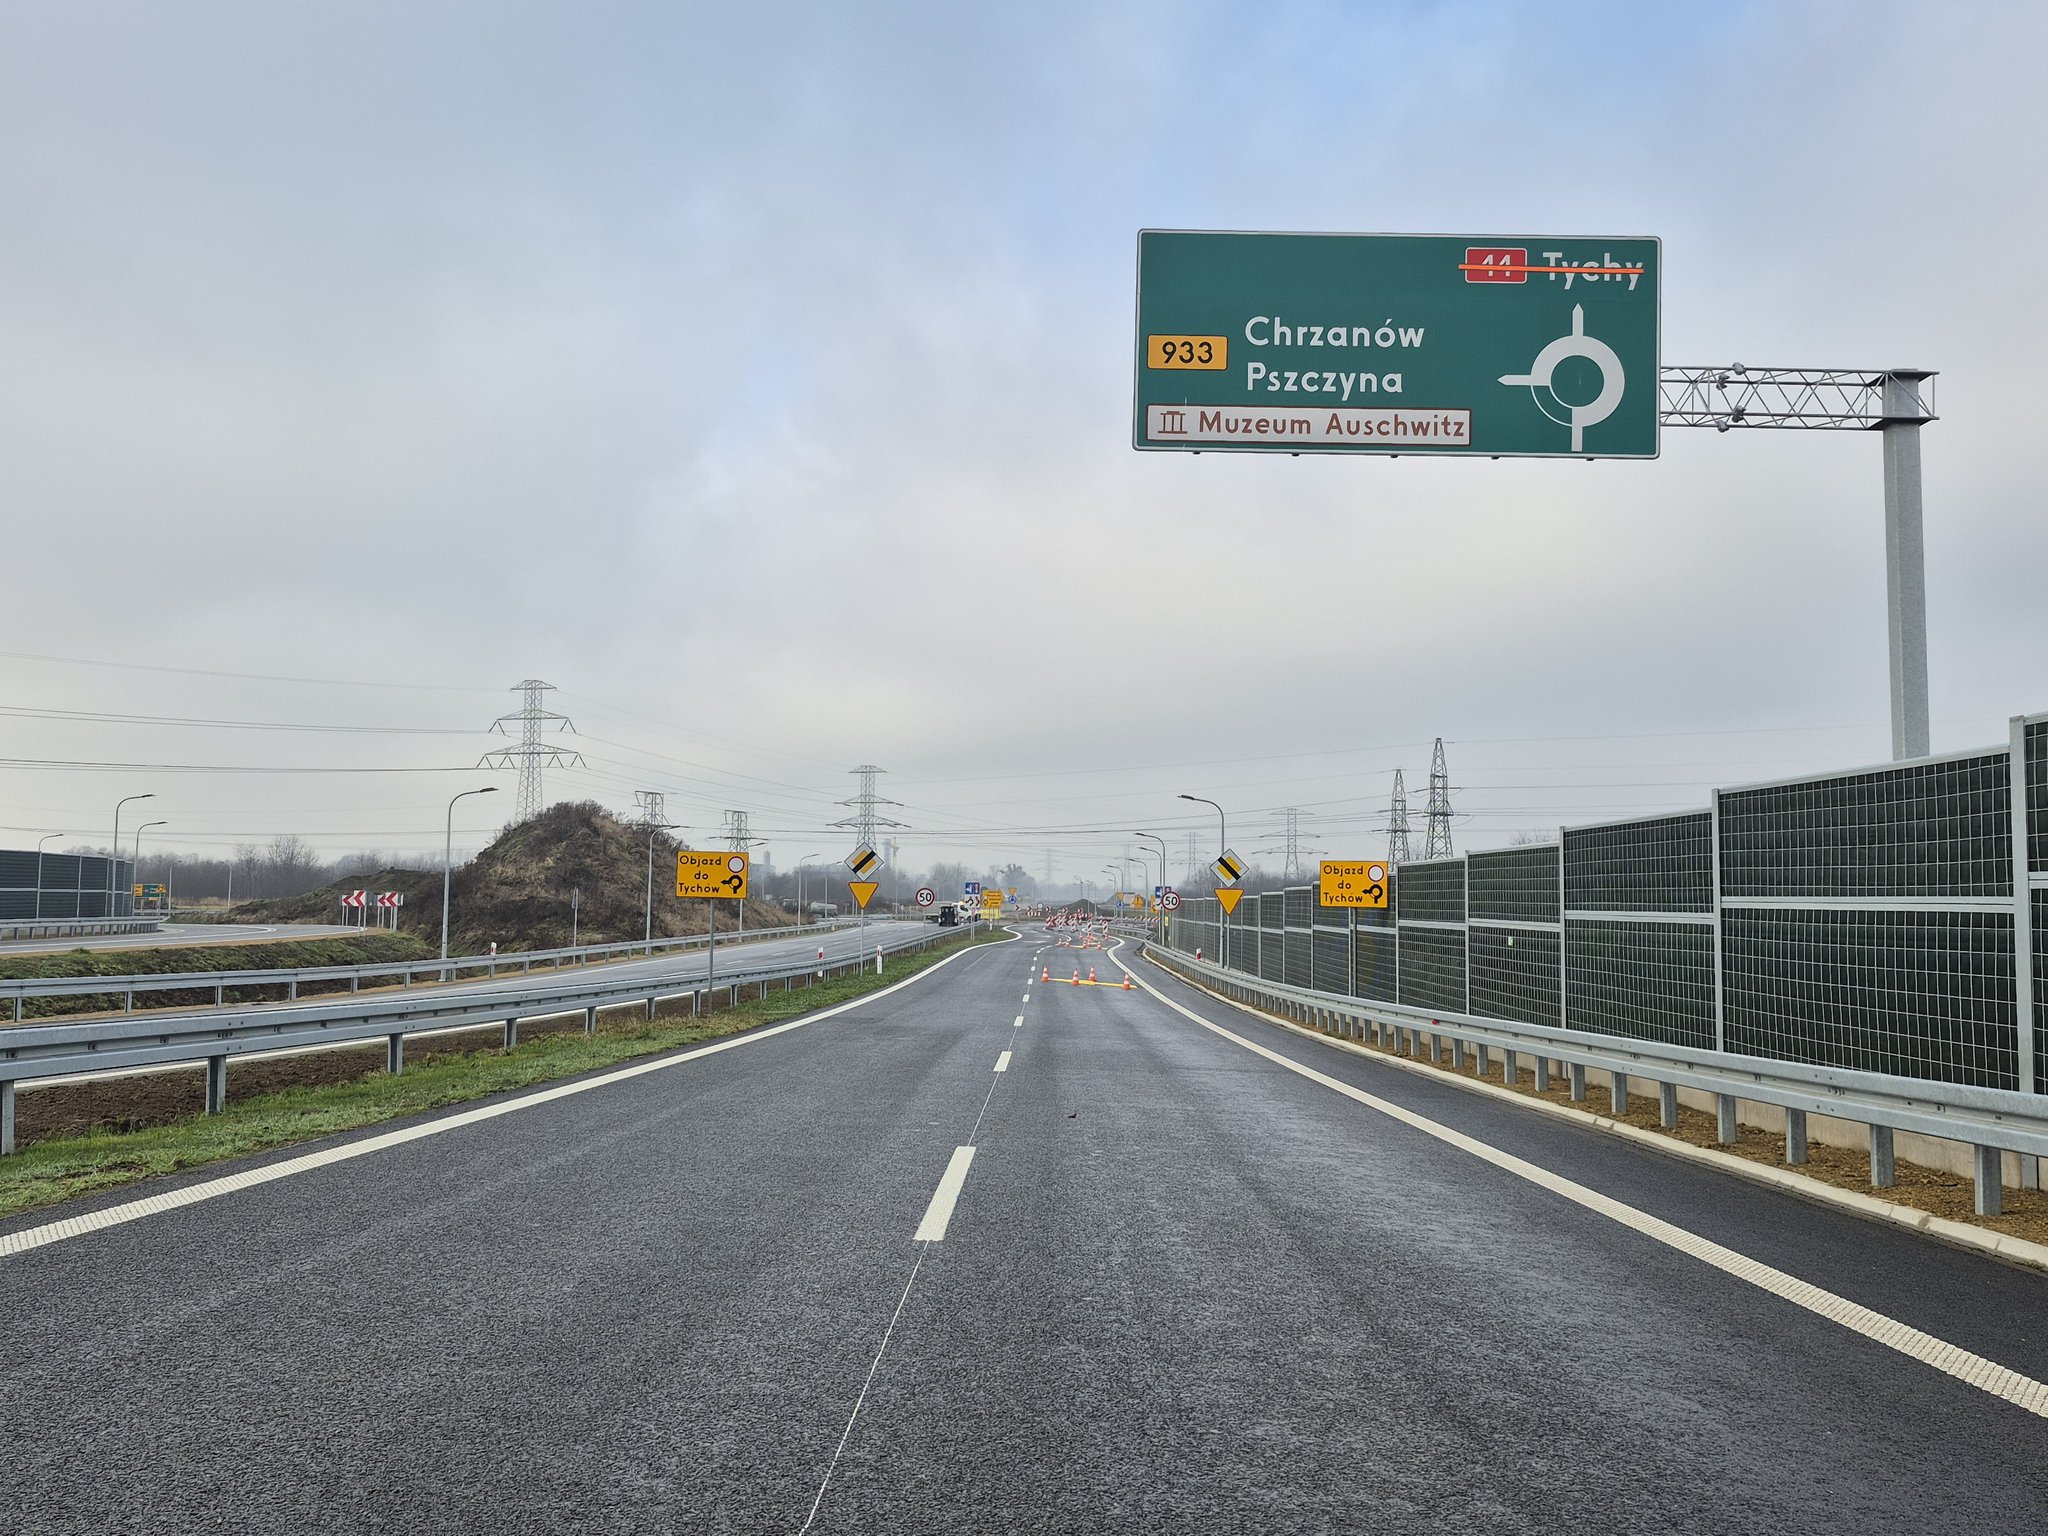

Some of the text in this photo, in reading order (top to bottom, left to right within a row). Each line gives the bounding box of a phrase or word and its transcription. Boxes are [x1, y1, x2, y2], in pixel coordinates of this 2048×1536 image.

[1542, 252, 1643, 291] Tychy
[1244, 316, 1425, 348] Chrzanów
[1161, 341, 1214, 364] 933
[1247, 362, 1403, 401] Pszczyna
[1199, 411, 1465, 437] Muzeum Auschwitz
[679, 855, 722, 867] Objazd
[694, 870, 709, 880] do
[1323, 865, 1364, 877] Objazd
[678, 883, 720, 895] Tychów
[1337, 880, 1352, 890] do
[919, 892, 932, 902] 50
[1165, 896, 1178, 906] 50
[1323, 892, 1363, 904] Tychów
